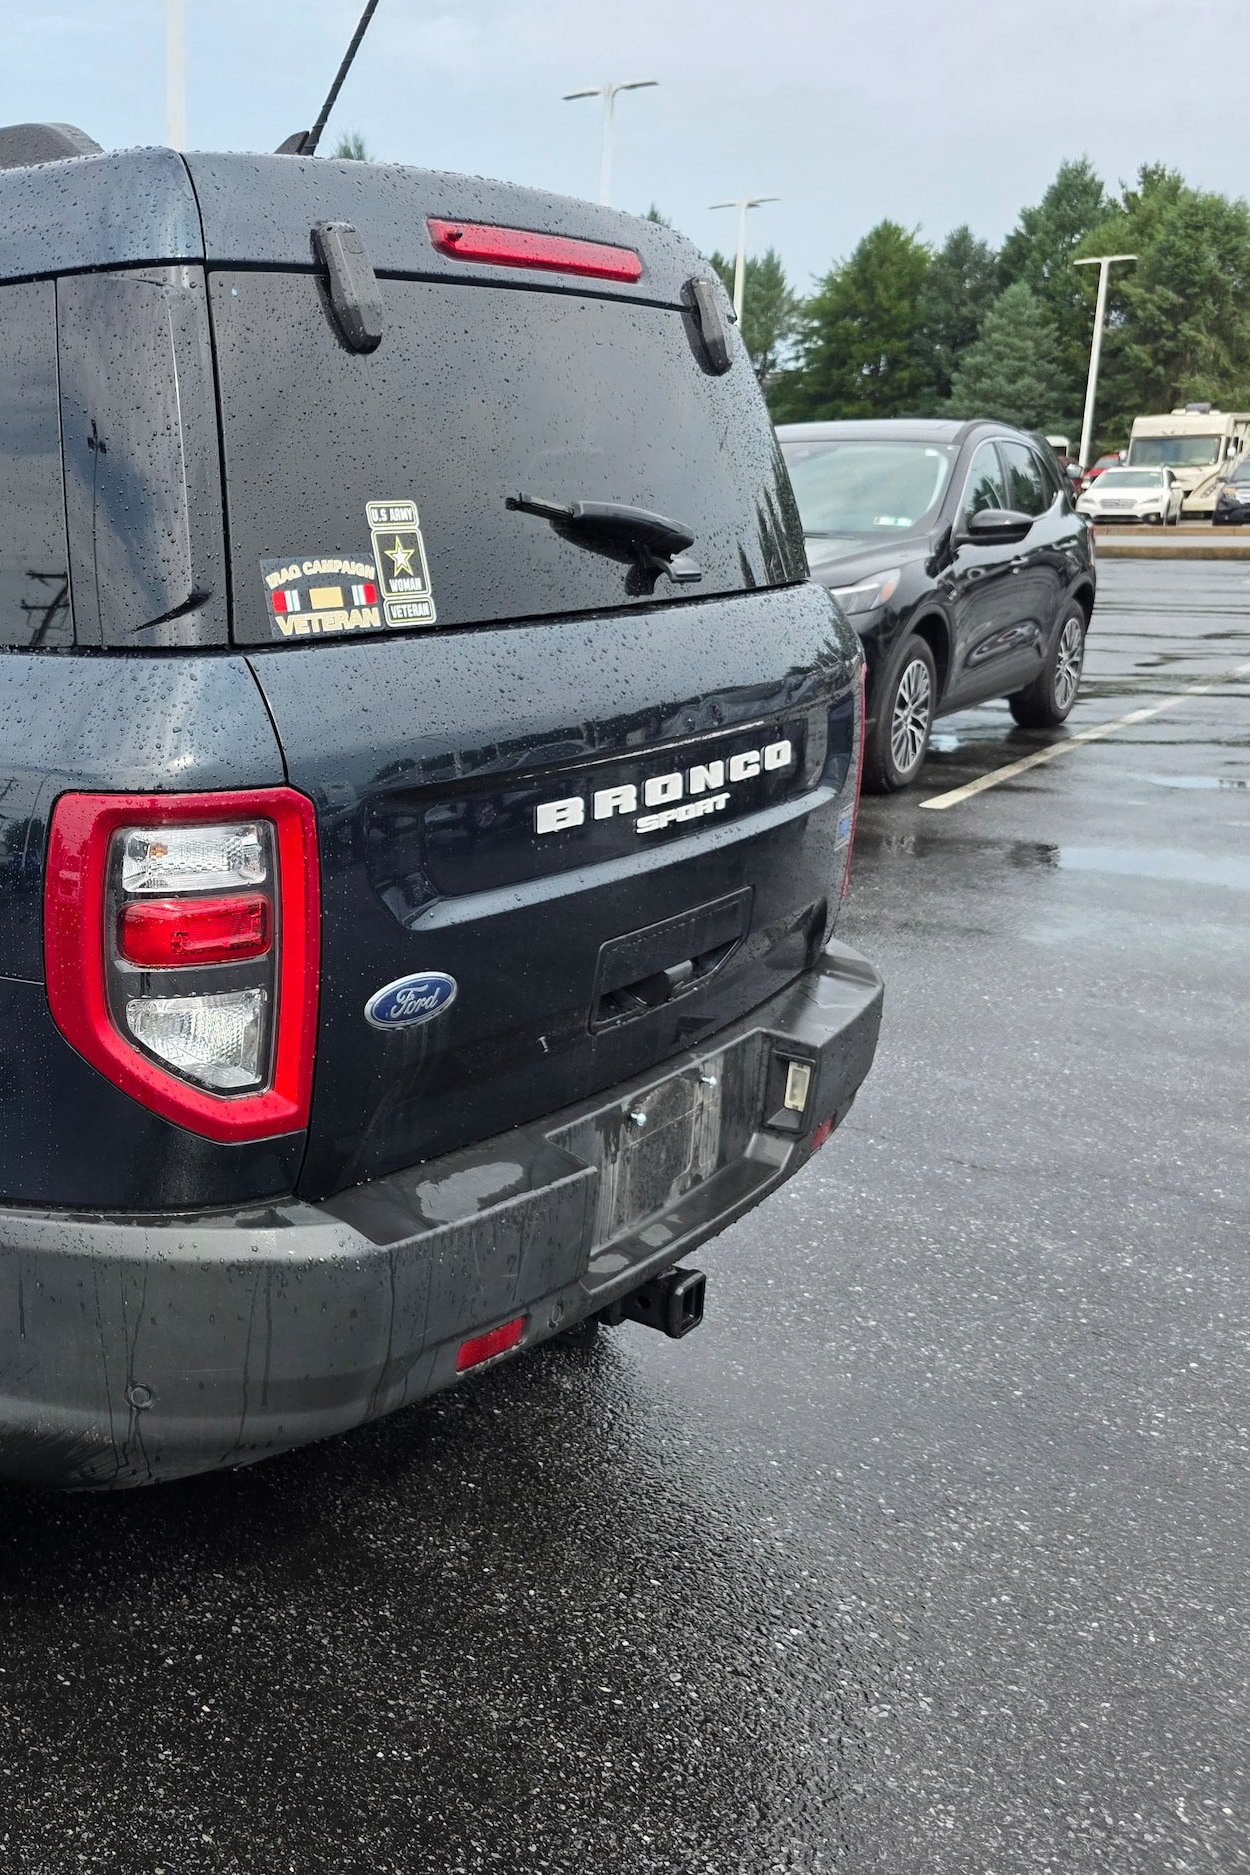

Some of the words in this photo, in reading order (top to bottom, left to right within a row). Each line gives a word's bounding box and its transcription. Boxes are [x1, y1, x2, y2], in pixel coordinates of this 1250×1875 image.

[389, 508, 413, 522] ARMY
[265, 565, 302, 590] IRAQ
[302, 559, 376, 581] CAMPAIGN
[389, 578, 422, 593] WOMAN
[275, 607, 381, 636] VETERAN
[390, 602, 431, 619] VETERAN
[535, 739, 792, 835] BRONCO
[635, 792, 731, 834] SPORT
[390, 984, 441, 1019] Ford
